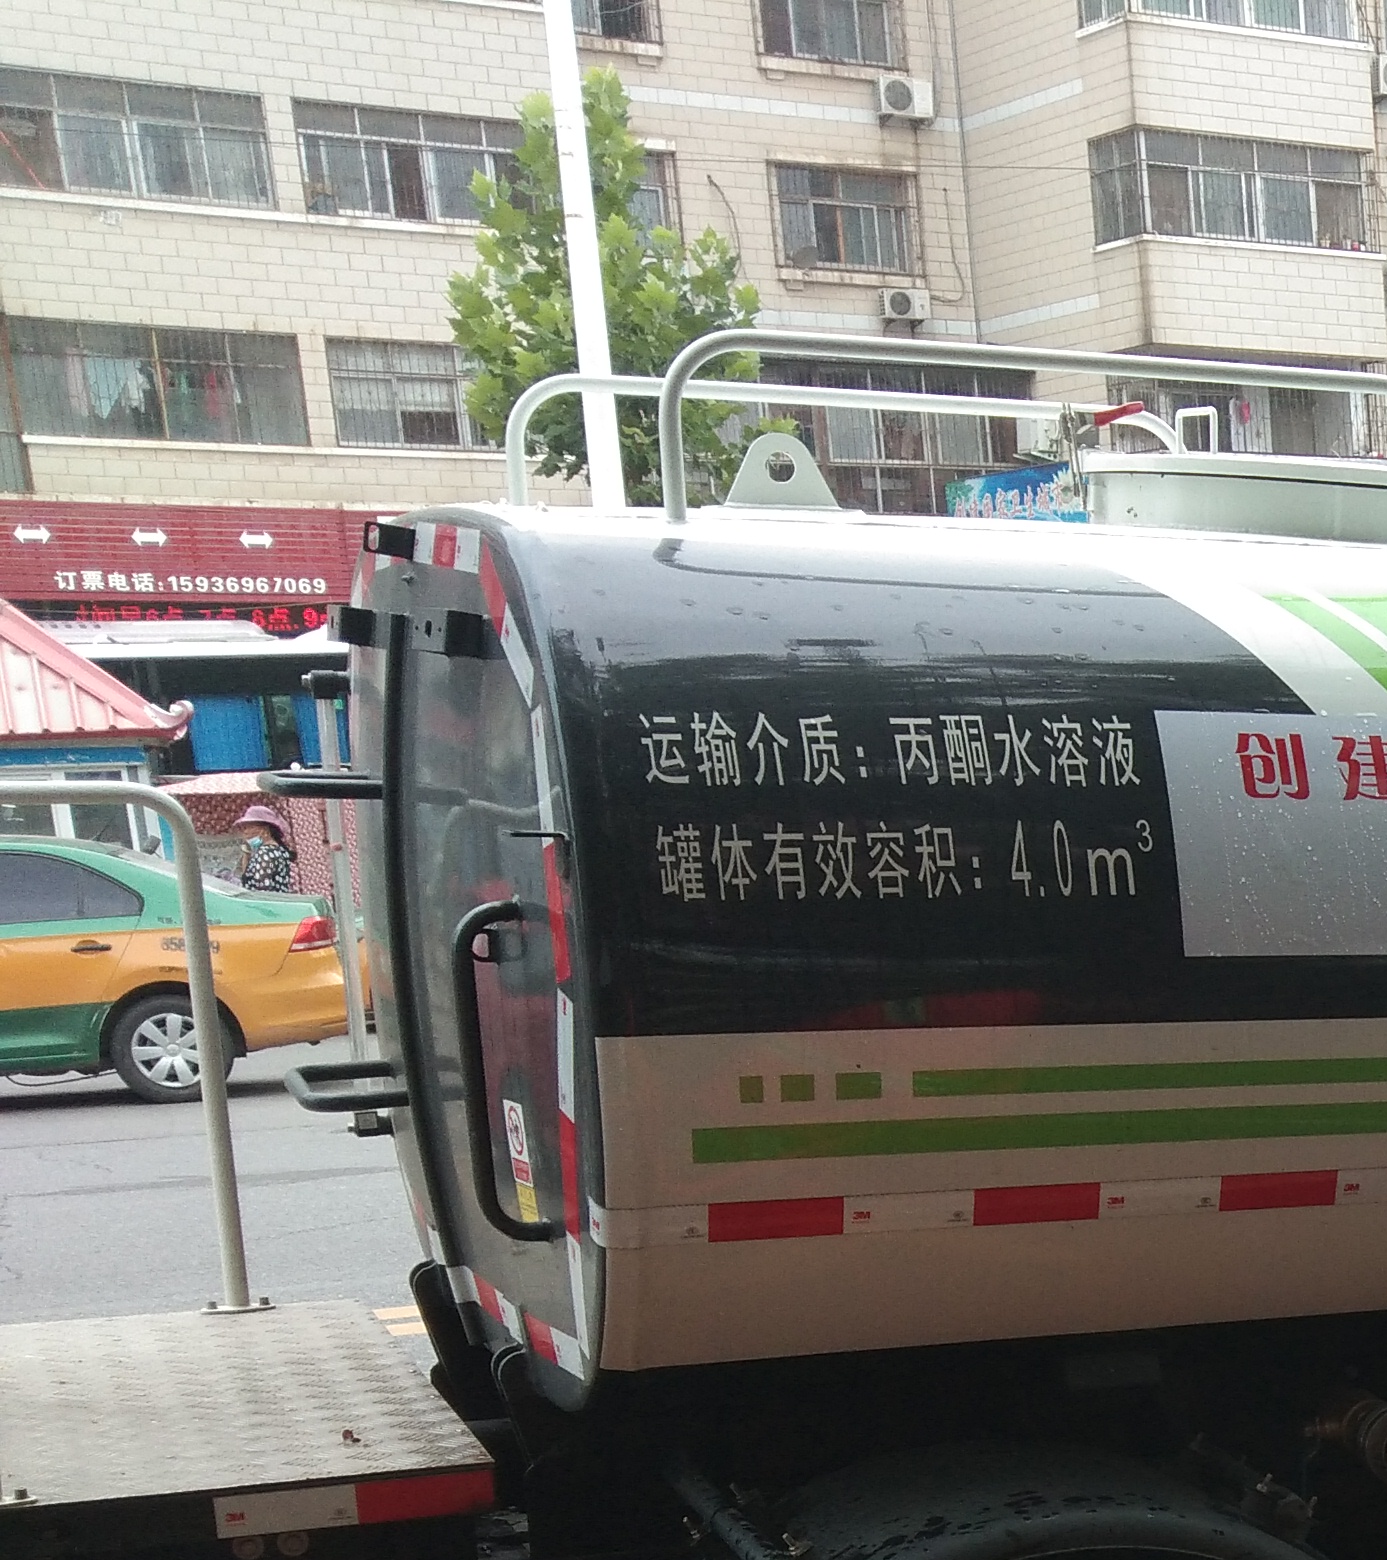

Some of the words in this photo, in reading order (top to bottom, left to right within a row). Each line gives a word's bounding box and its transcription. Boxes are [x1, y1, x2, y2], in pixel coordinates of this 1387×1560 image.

[54, 570, 327, 593] 订票电话:15936967069
[638, 711, 1142, 788] 运输介质：丙酮水溶液
